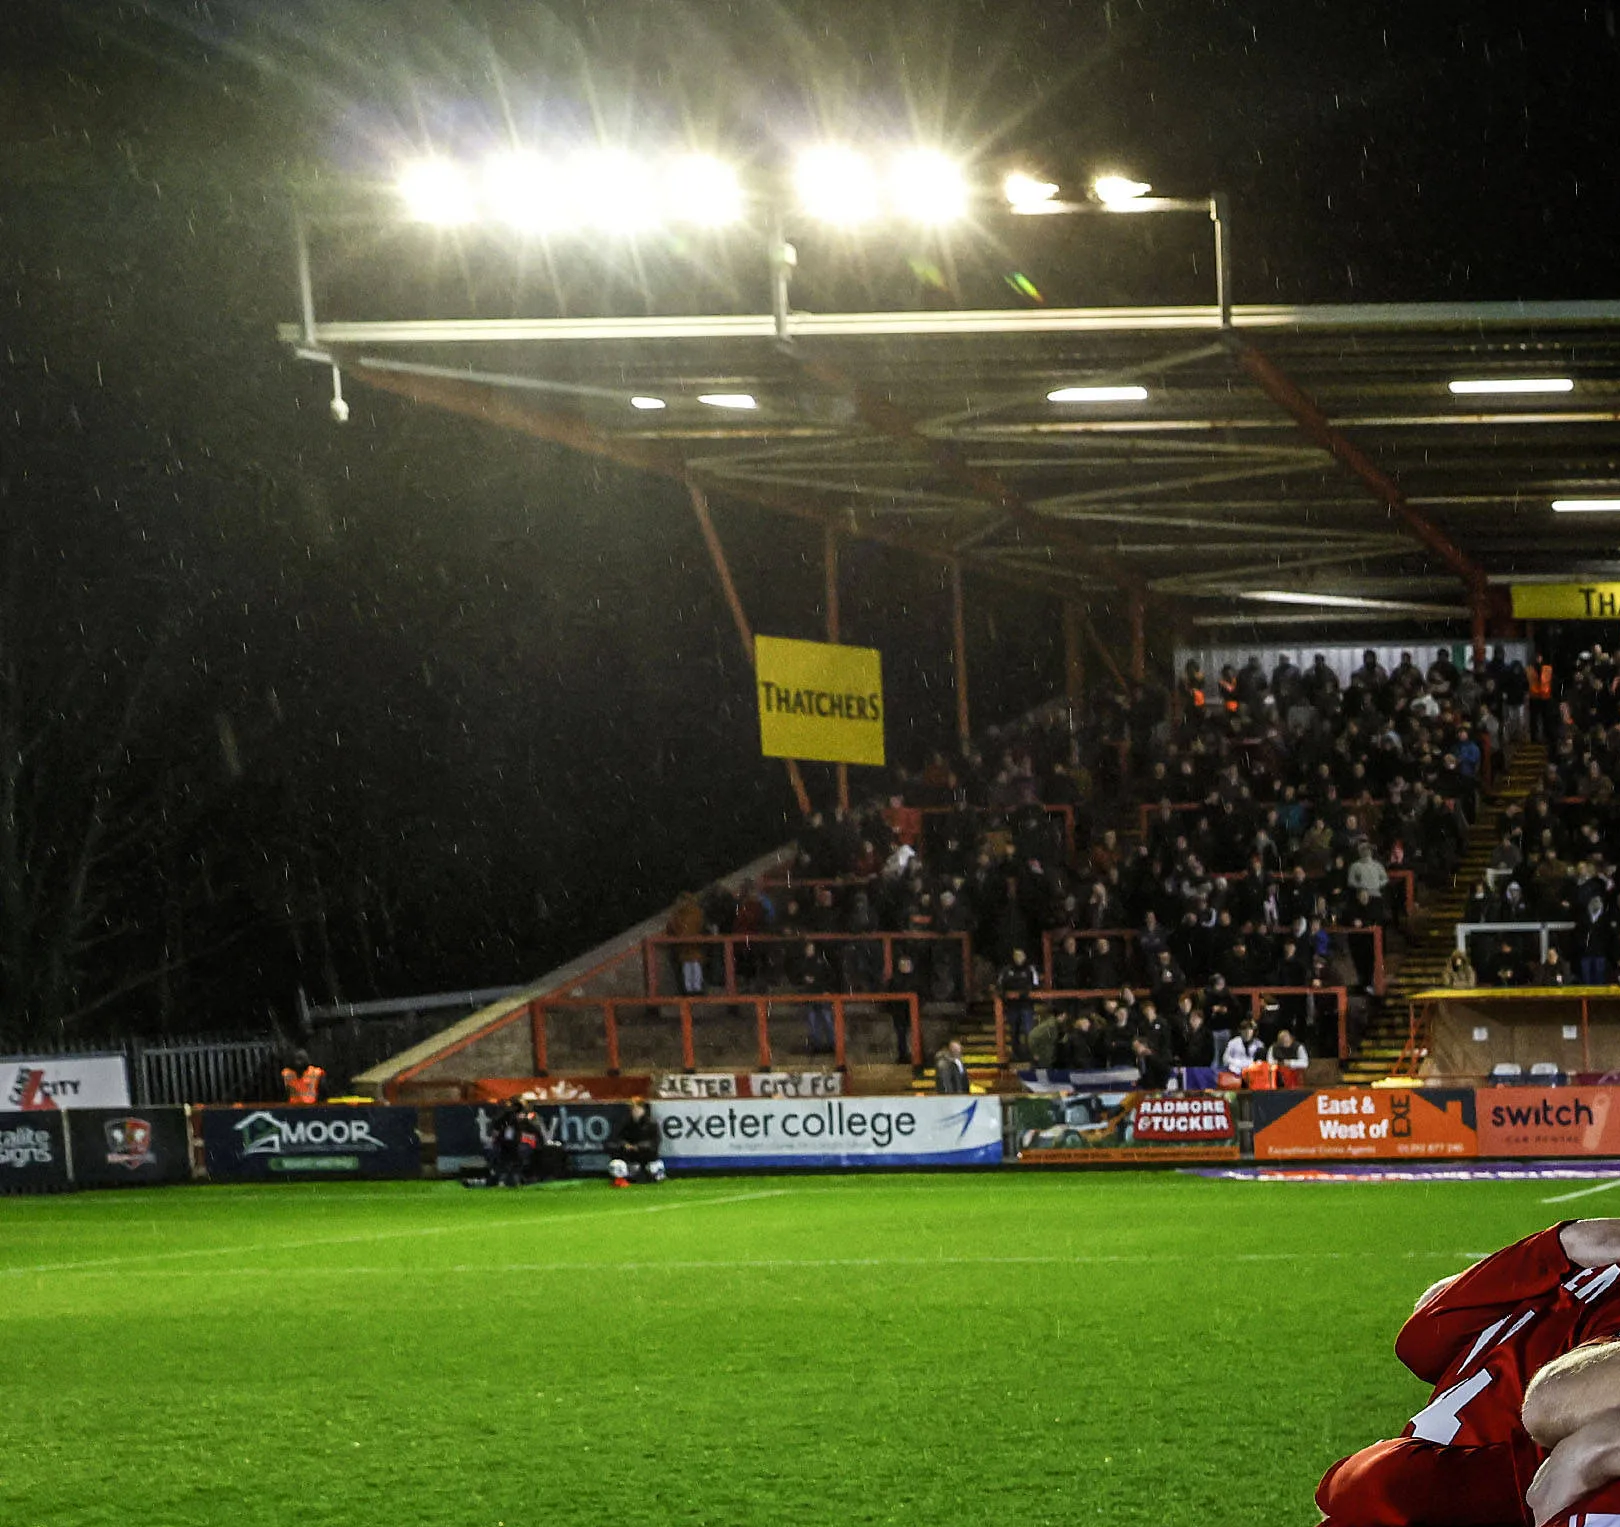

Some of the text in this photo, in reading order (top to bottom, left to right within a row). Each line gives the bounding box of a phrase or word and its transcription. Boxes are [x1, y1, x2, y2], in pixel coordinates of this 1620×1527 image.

[810, 1075, 836, 1095] FC
[1139, 1101, 1226, 1115] RADMORE
[1316, 1094, 1376, 1115] East &
[1492, 1097, 1594, 1127] switch
[281, 1119, 376, 1146] MOOR
[662, 1101, 917, 1147] exeter college
[1319, 1118, 1389, 1140] West of
